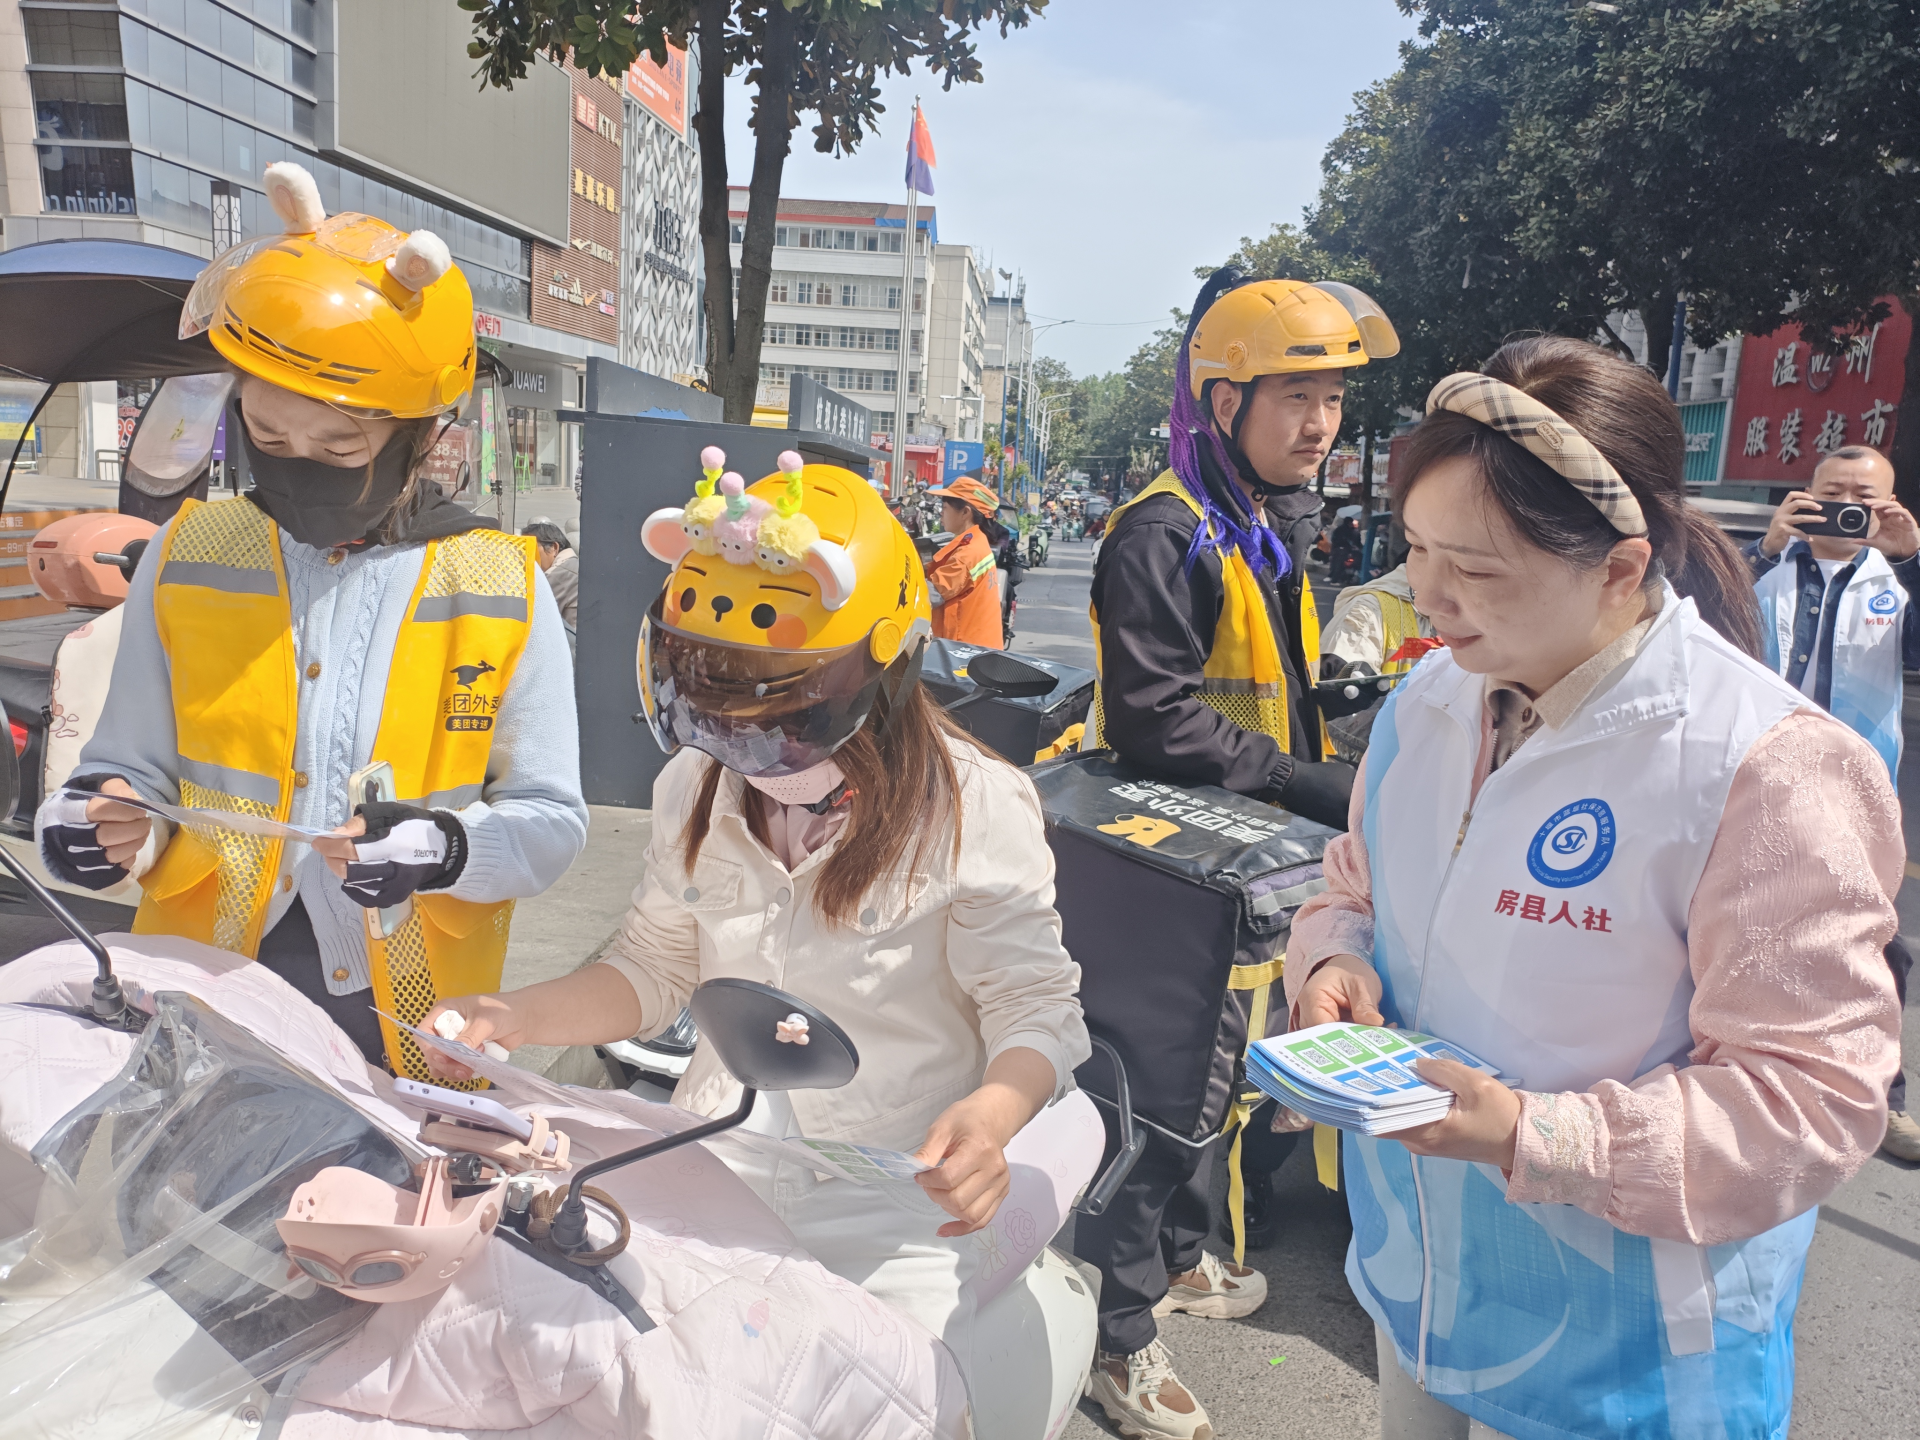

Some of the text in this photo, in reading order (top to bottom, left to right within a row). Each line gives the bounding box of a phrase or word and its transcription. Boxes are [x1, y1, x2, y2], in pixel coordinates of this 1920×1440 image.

[578, 95, 595, 128] 皇后
[598, 111, 617, 143] KTV
[510, 369, 546, 393] HUAWEI
[1743, 399, 1894, 464] 服装超市
[953, 450, 968, 470] P
[452, 719, 488, 729] 美团专送
[1108, 783, 1276, 843] 美团外卖
[1211, 806, 1289, 832] 美团外卖
[1494, 889, 1612, 933] 房县人社
